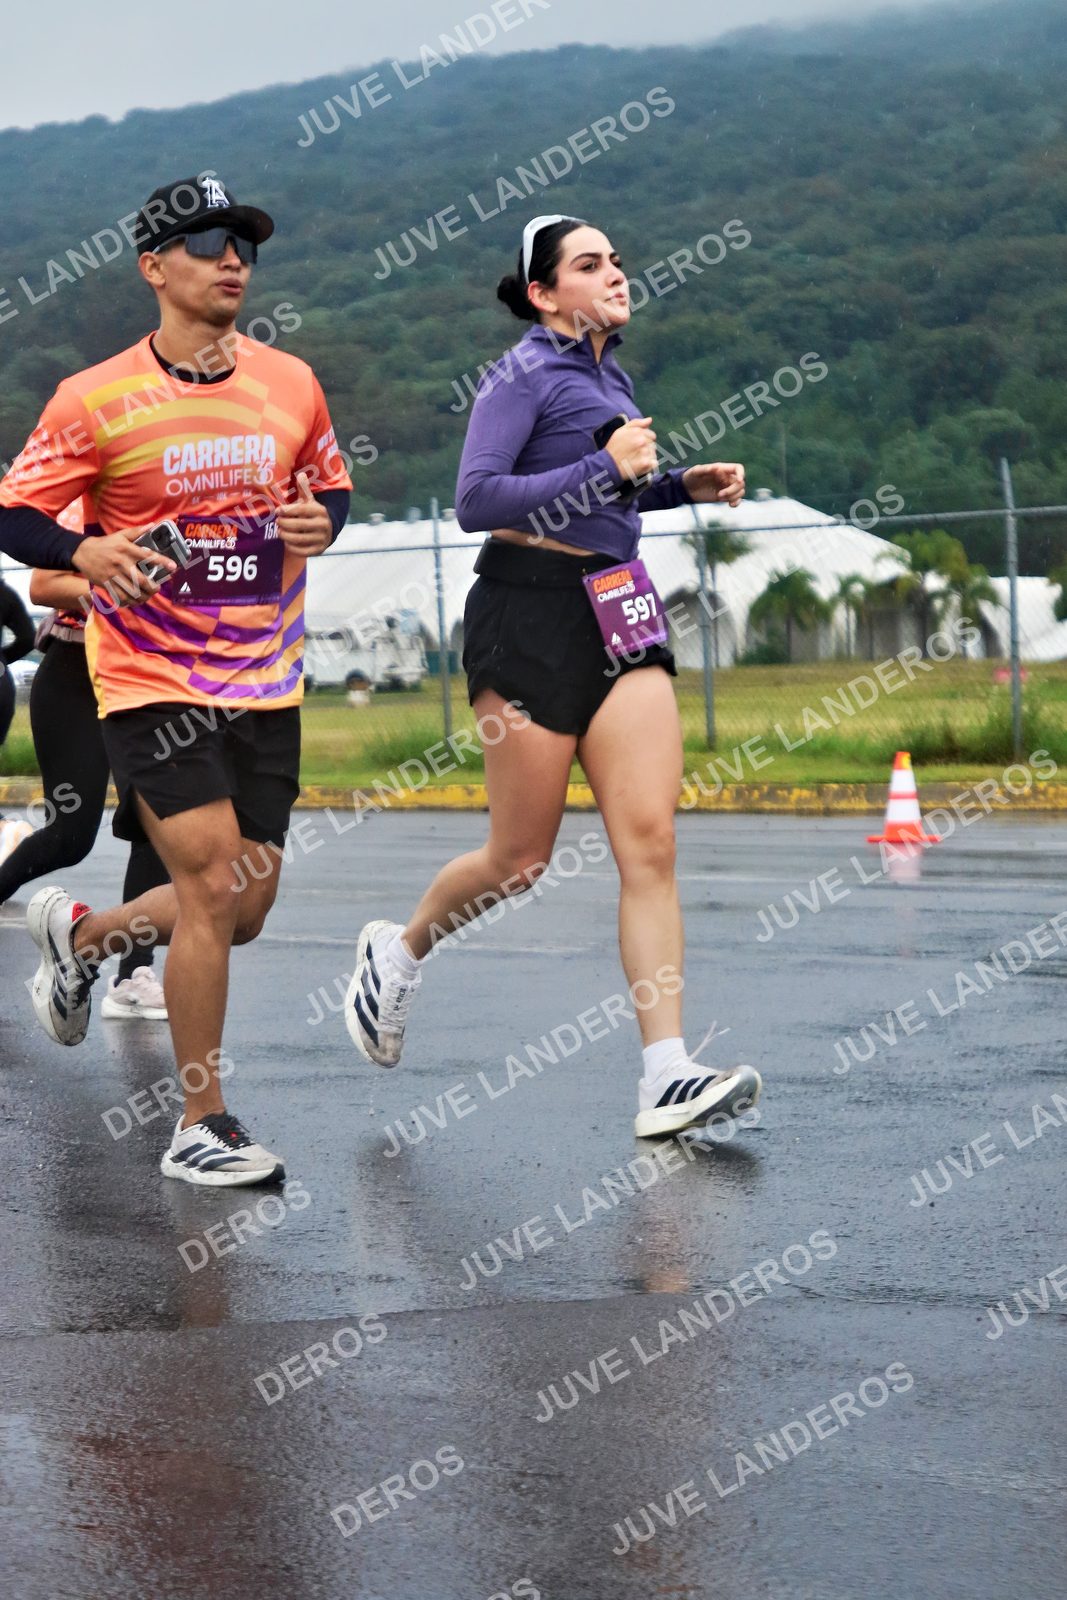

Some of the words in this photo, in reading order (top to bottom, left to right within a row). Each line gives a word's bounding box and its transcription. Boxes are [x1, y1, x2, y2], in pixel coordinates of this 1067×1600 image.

[202, 176, 231, 208] LA
[163, 434, 276, 476] CARRERA
[166, 468, 253, 497] OMNILIFE
[184, 538, 226, 549] OMNILIFE
[185, 522, 239, 539] CARRERA
[206, 554, 258, 582] 596
[593, 569, 633, 593] CARRERA
[621, 593, 657, 626] 597
